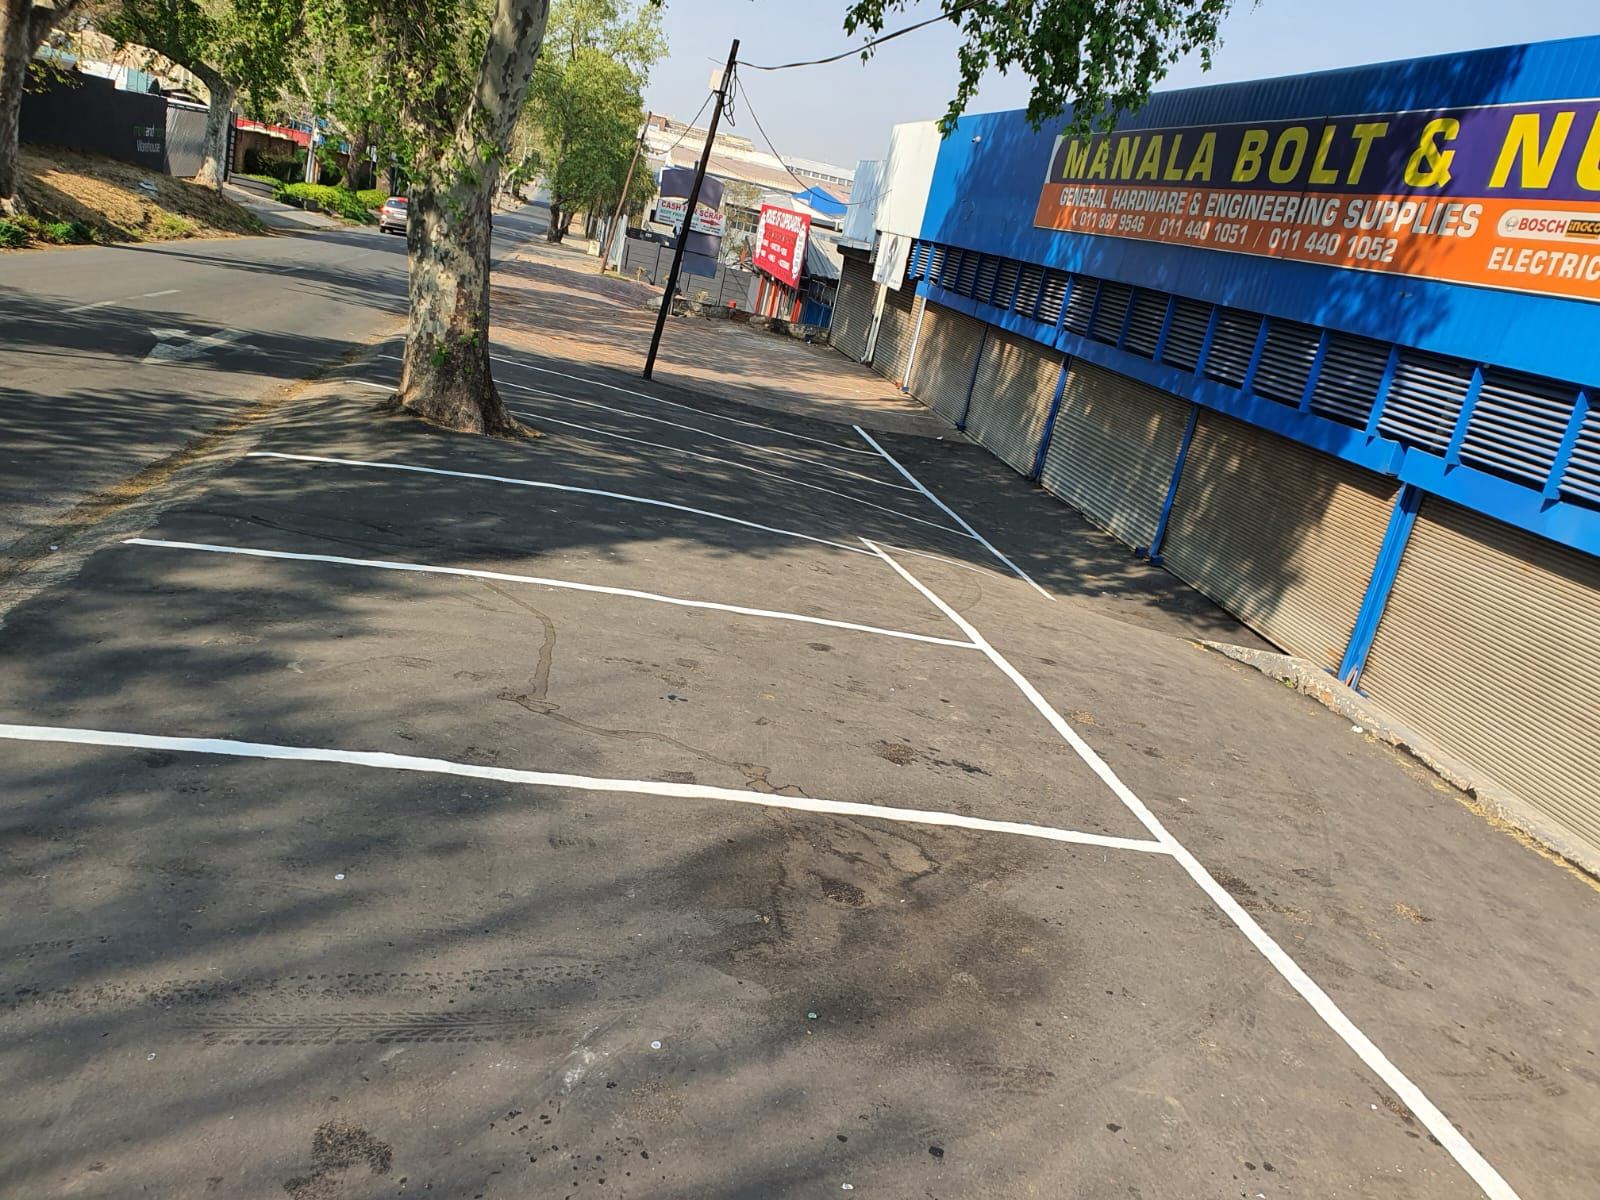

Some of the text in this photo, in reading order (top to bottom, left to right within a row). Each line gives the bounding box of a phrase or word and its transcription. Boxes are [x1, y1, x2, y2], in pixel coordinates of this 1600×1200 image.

[1062, 132, 1217, 181] MANALA
[1231, 122, 1389, 185] BOLT
[1404, 118, 1460, 189] &
[661, 200, 681, 211] CASH
[700, 209, 724, 221] SCRAP
[1060, 187, 1483, 238] GENERAL HARDWARE & ENGINEERING SUPPLIES
[1518, 218, 1567, 233] BOSCH
[1080, 213, 1097, 226] 011
[1118, 216, 1146, 232] 9546
[1159, 218, 1182, 238] 011
[1184, 220, 1210, 240] 440
[1214, 222, 1248, 244] 1051
[1268, 227, 1302, 251] 011
[1304, 231, 1341, 256] 440
[1347, 235, 1398, 262] 1052
